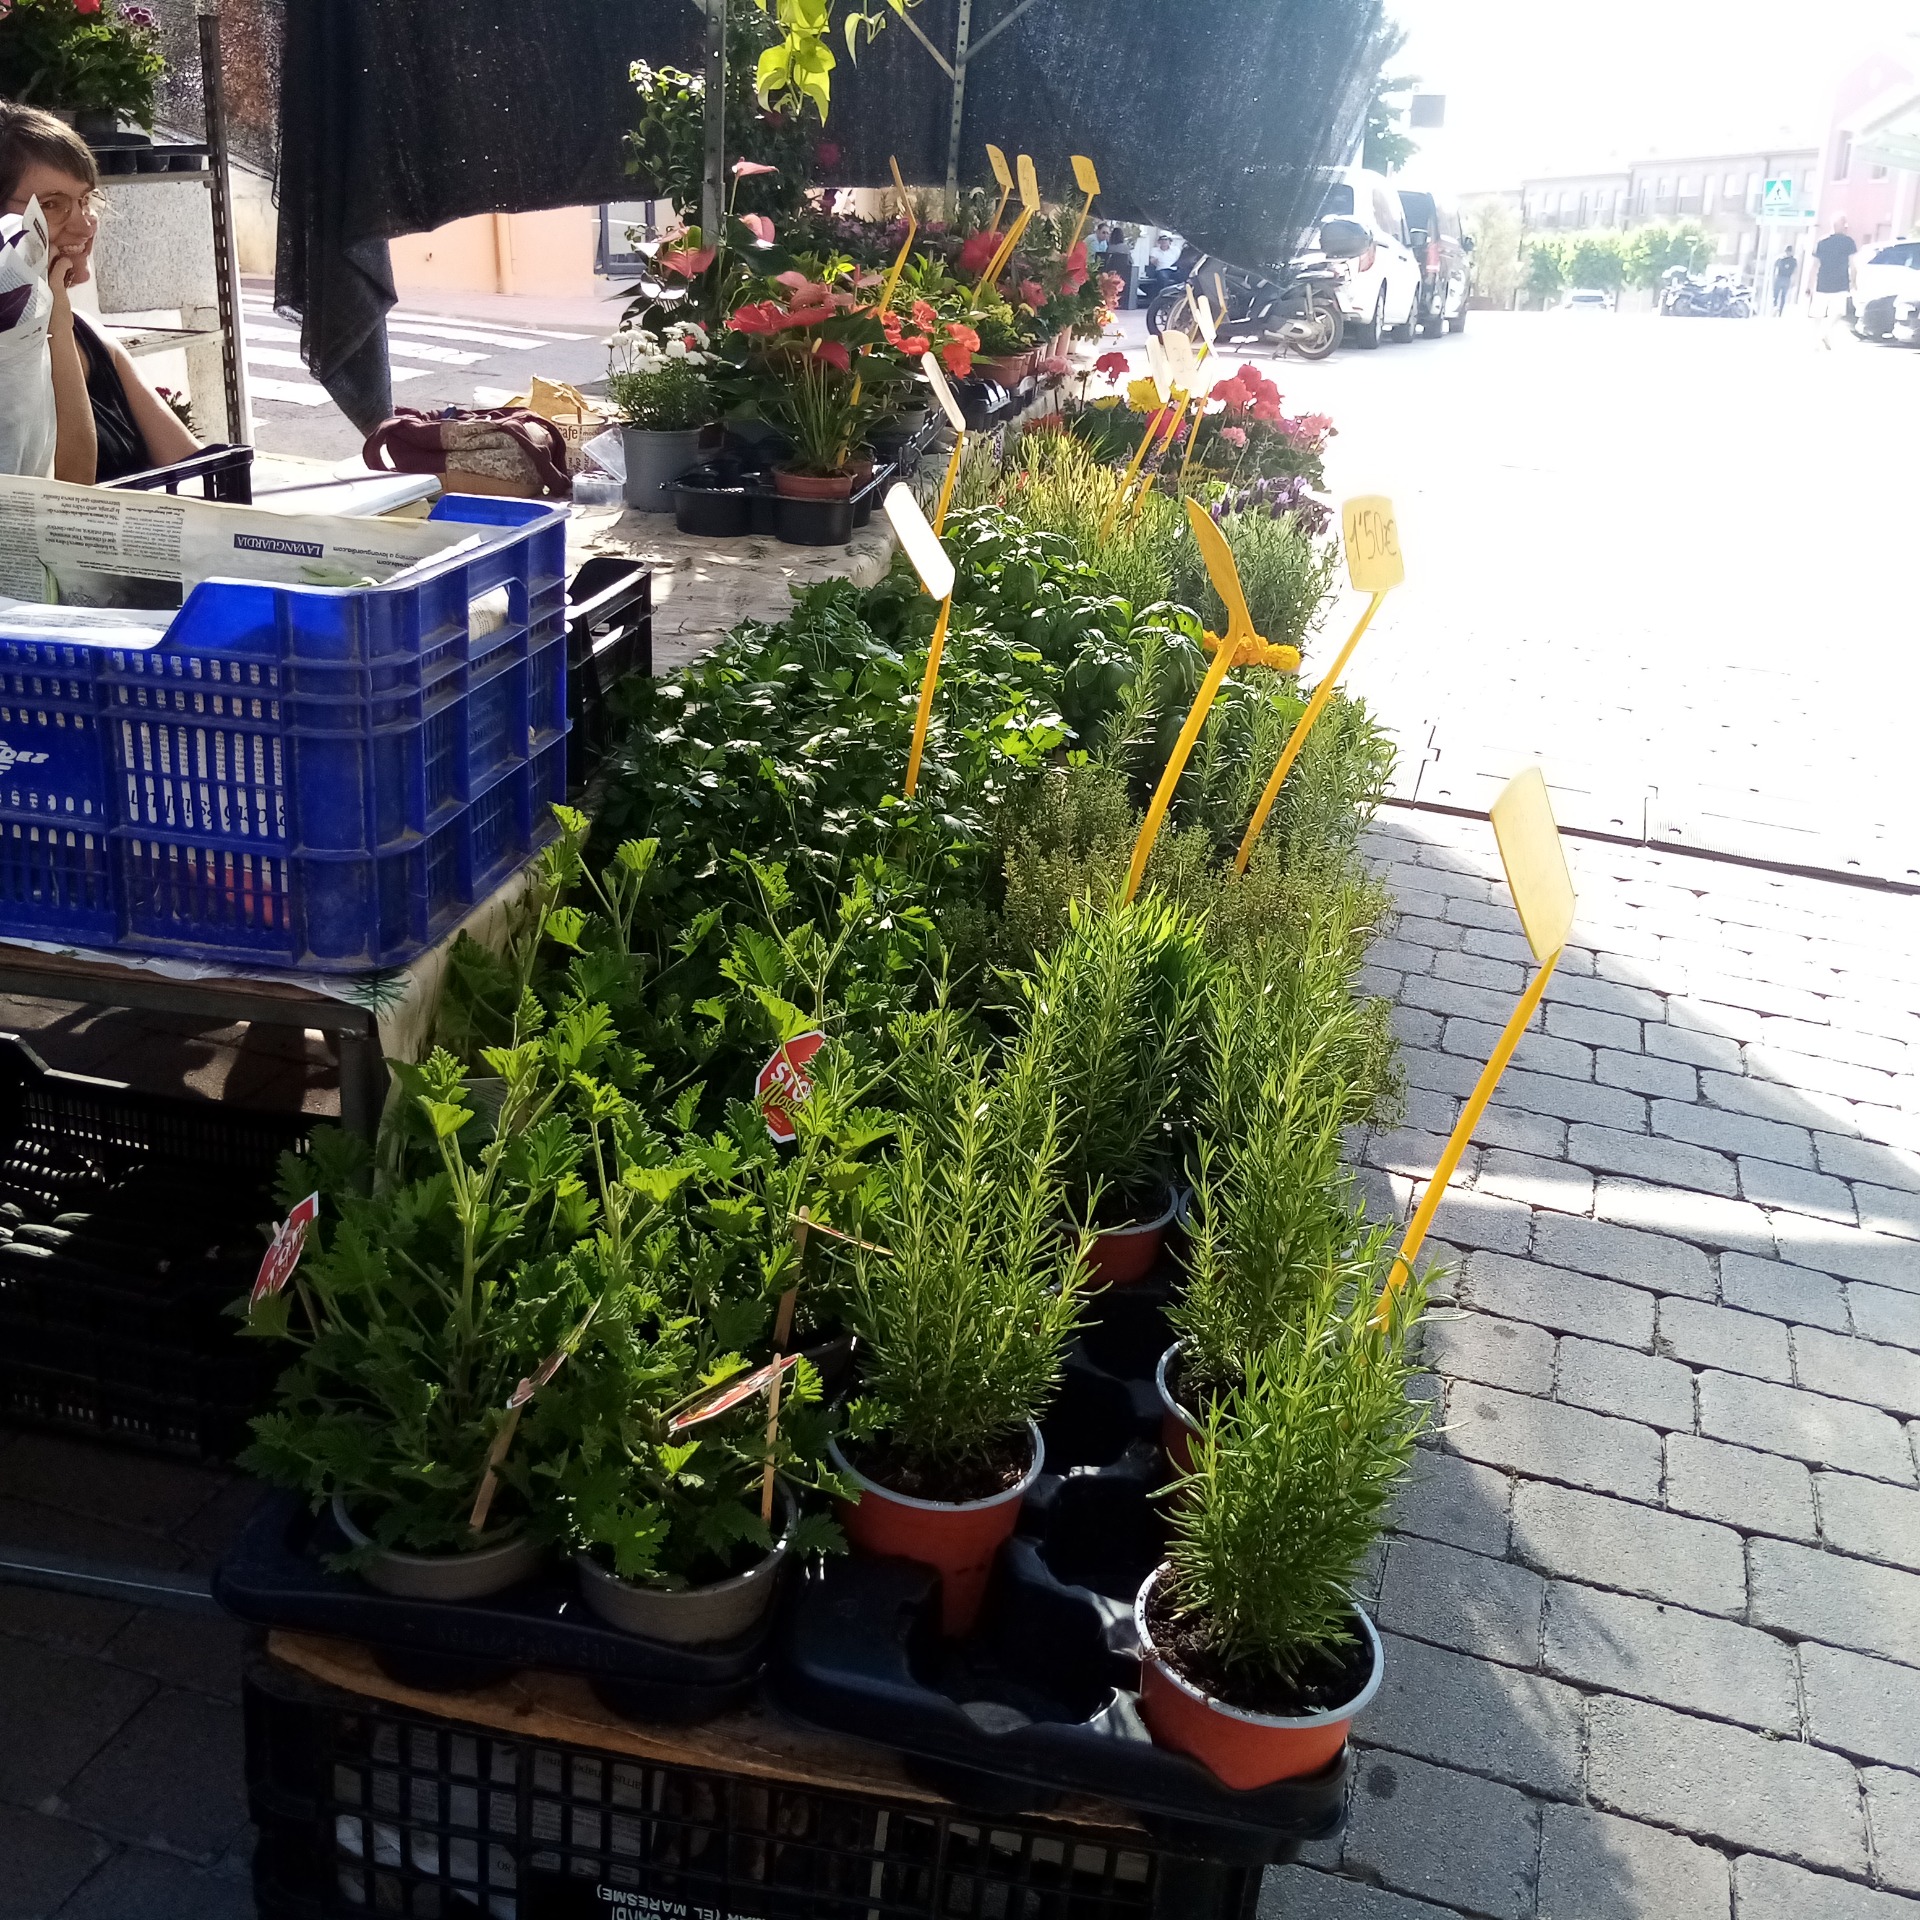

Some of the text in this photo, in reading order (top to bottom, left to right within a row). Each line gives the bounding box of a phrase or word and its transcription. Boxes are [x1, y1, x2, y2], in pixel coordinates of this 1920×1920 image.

[332, 545, 388, 558] lavanguardia.com
[770, 1062, 812, 1103] STO
[596, 1883, 687, 1916] MARESME)
